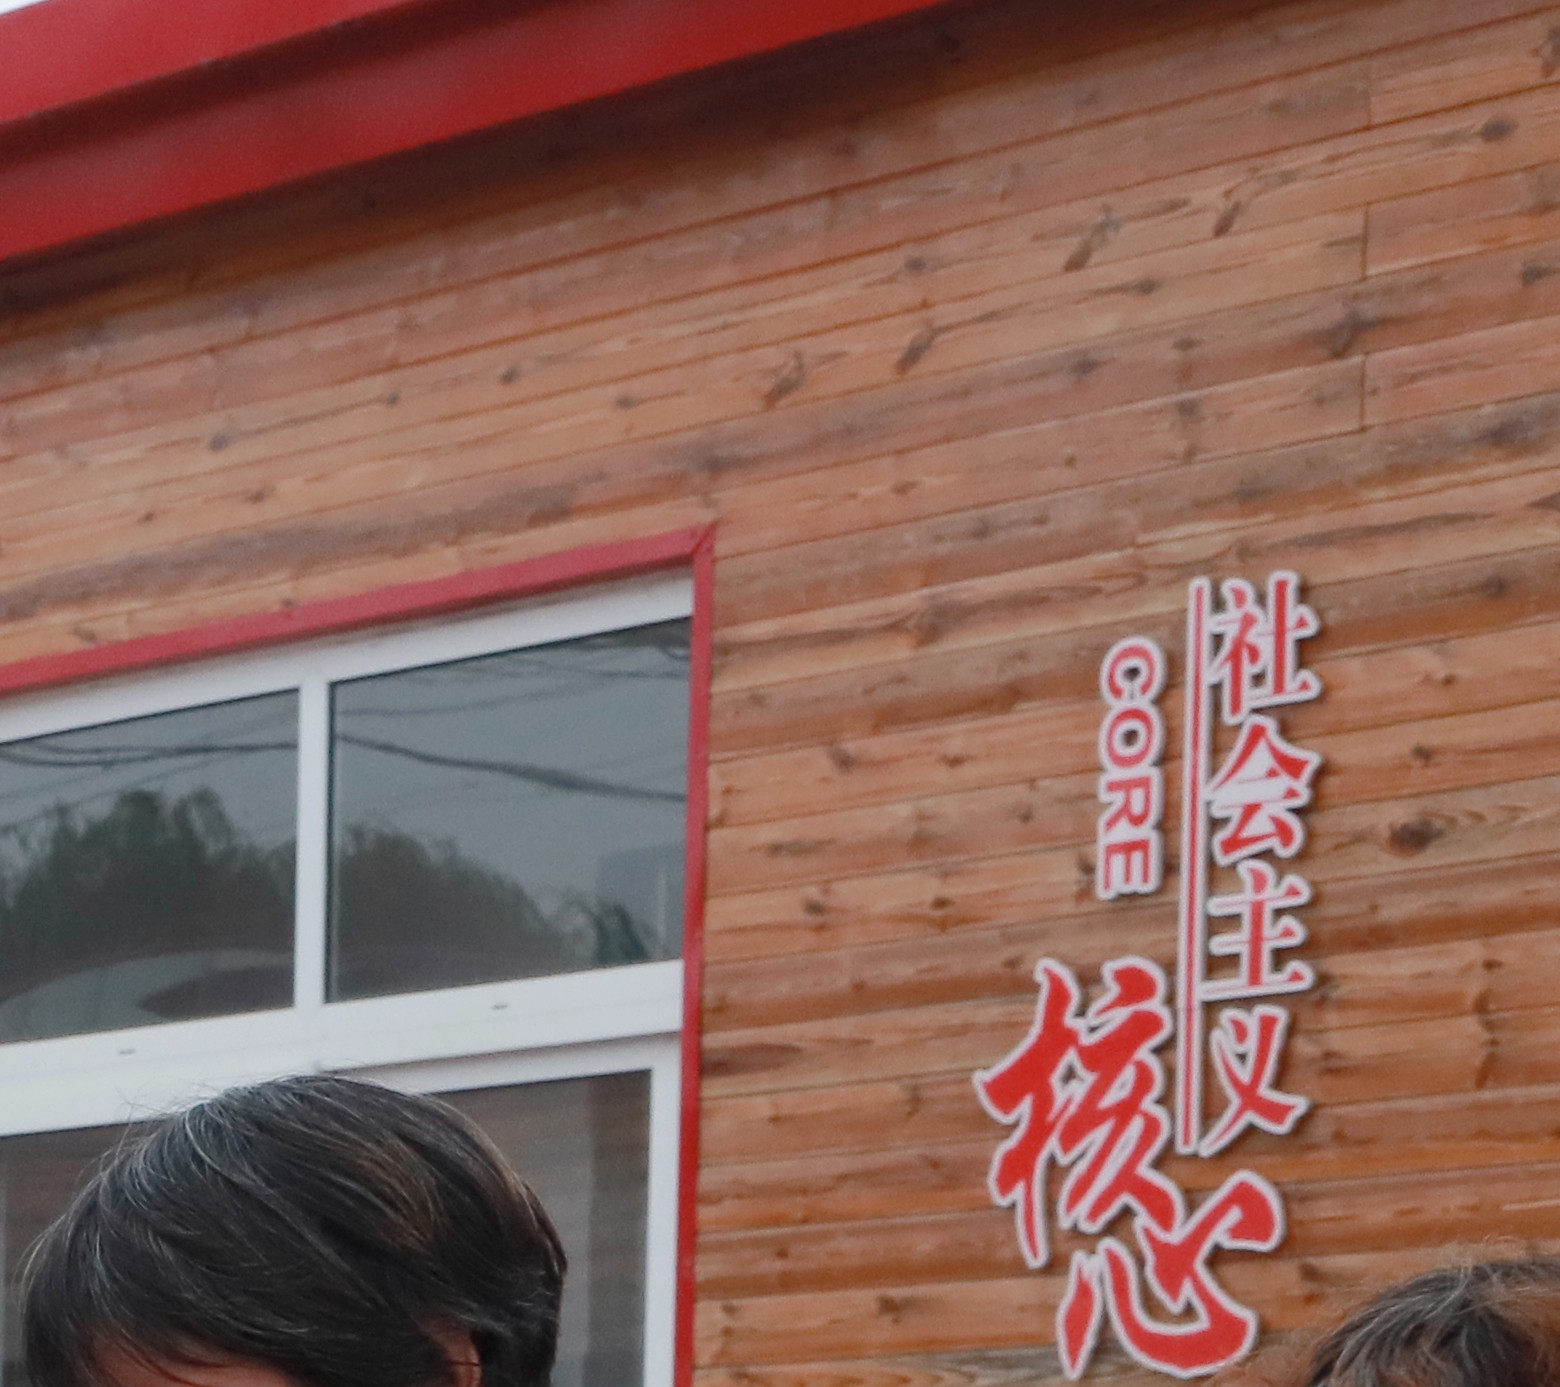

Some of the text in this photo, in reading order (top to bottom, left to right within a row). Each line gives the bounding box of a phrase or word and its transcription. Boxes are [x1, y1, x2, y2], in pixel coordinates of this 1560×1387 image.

[1099, 639, 1164, 898] CORE
[1205, 570, 1321, 1156] 社会主义
[975, 960, 1282, 1376] 核心
